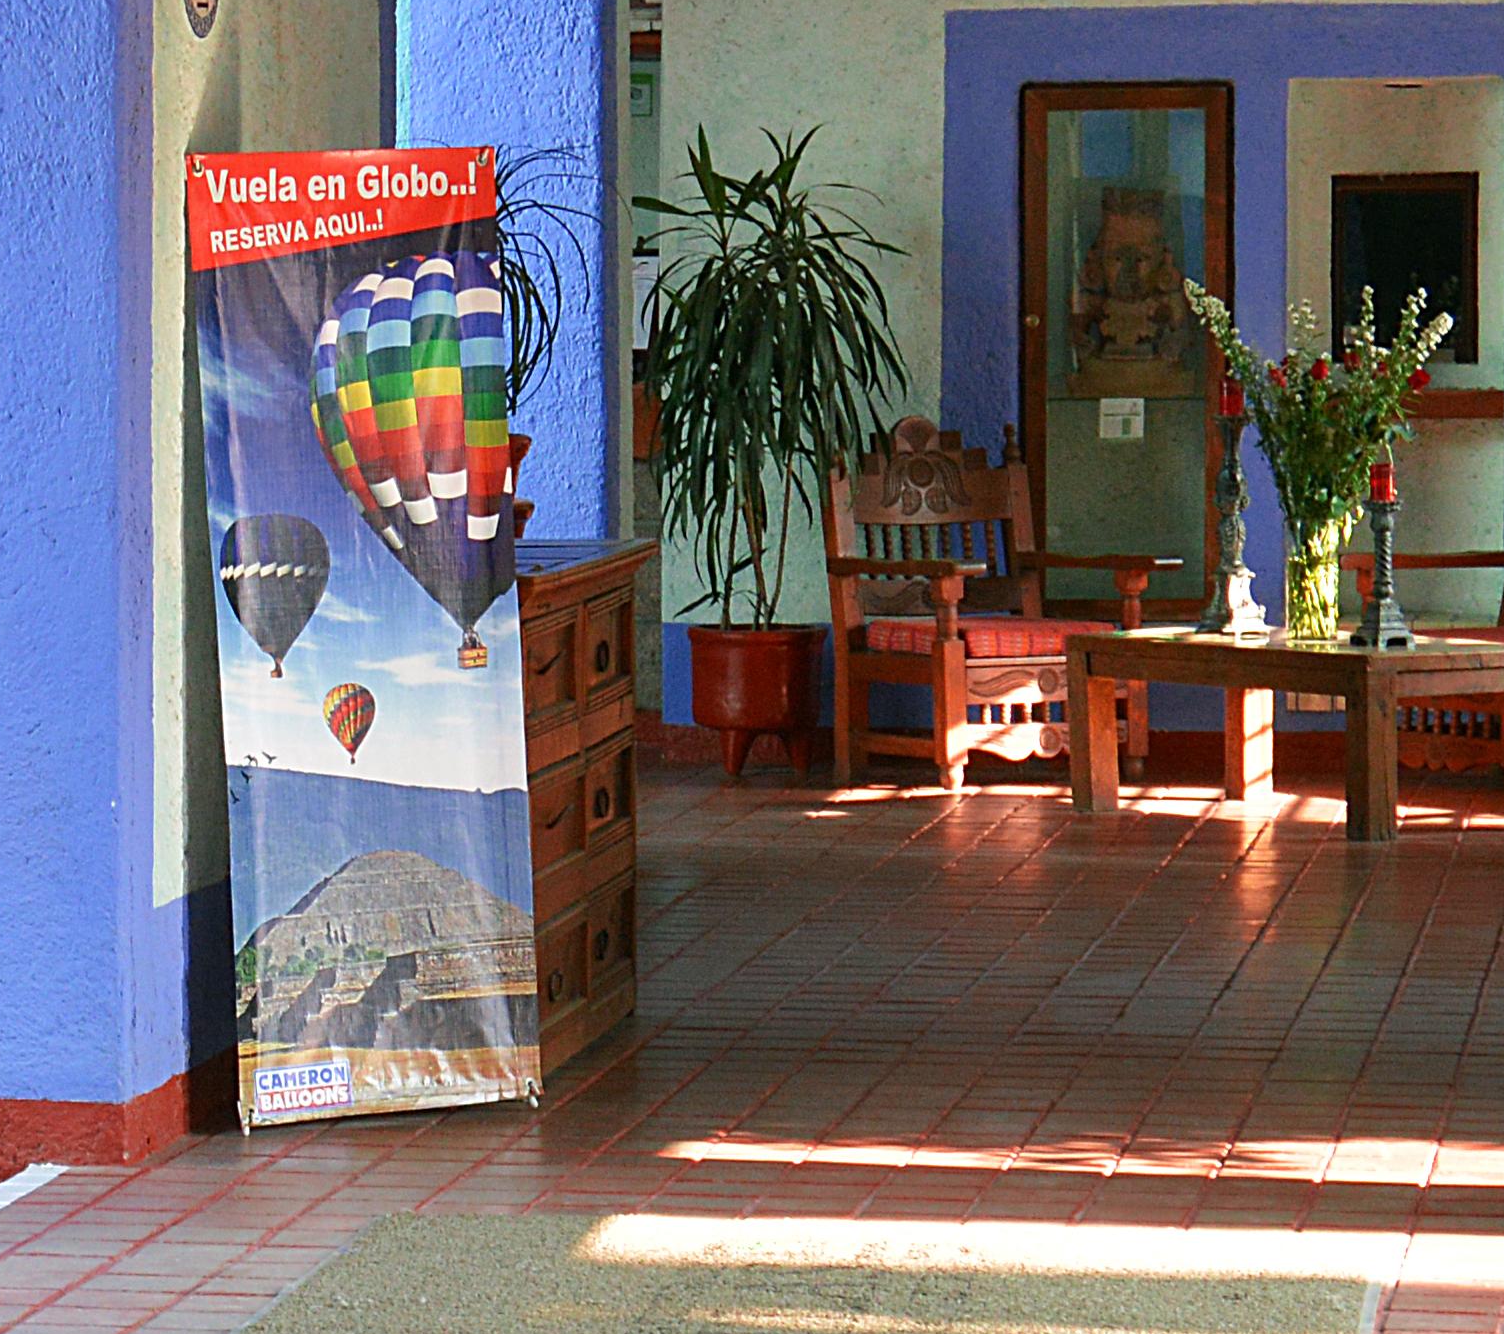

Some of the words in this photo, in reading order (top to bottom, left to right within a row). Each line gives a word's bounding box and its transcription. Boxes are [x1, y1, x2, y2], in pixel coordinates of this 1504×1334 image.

[205, 168, 297, 204] Vuela
[308, 174, 346, 201] en
[357, 161, 476, 200] Globo..!
[210, 219, 309, 254] RESERVA
[314, 208, 384, 240] AQUI..!
[258, 1067, 346, 1091] CAMERON
[259, 1086, 349, 1112] BALLOONS
